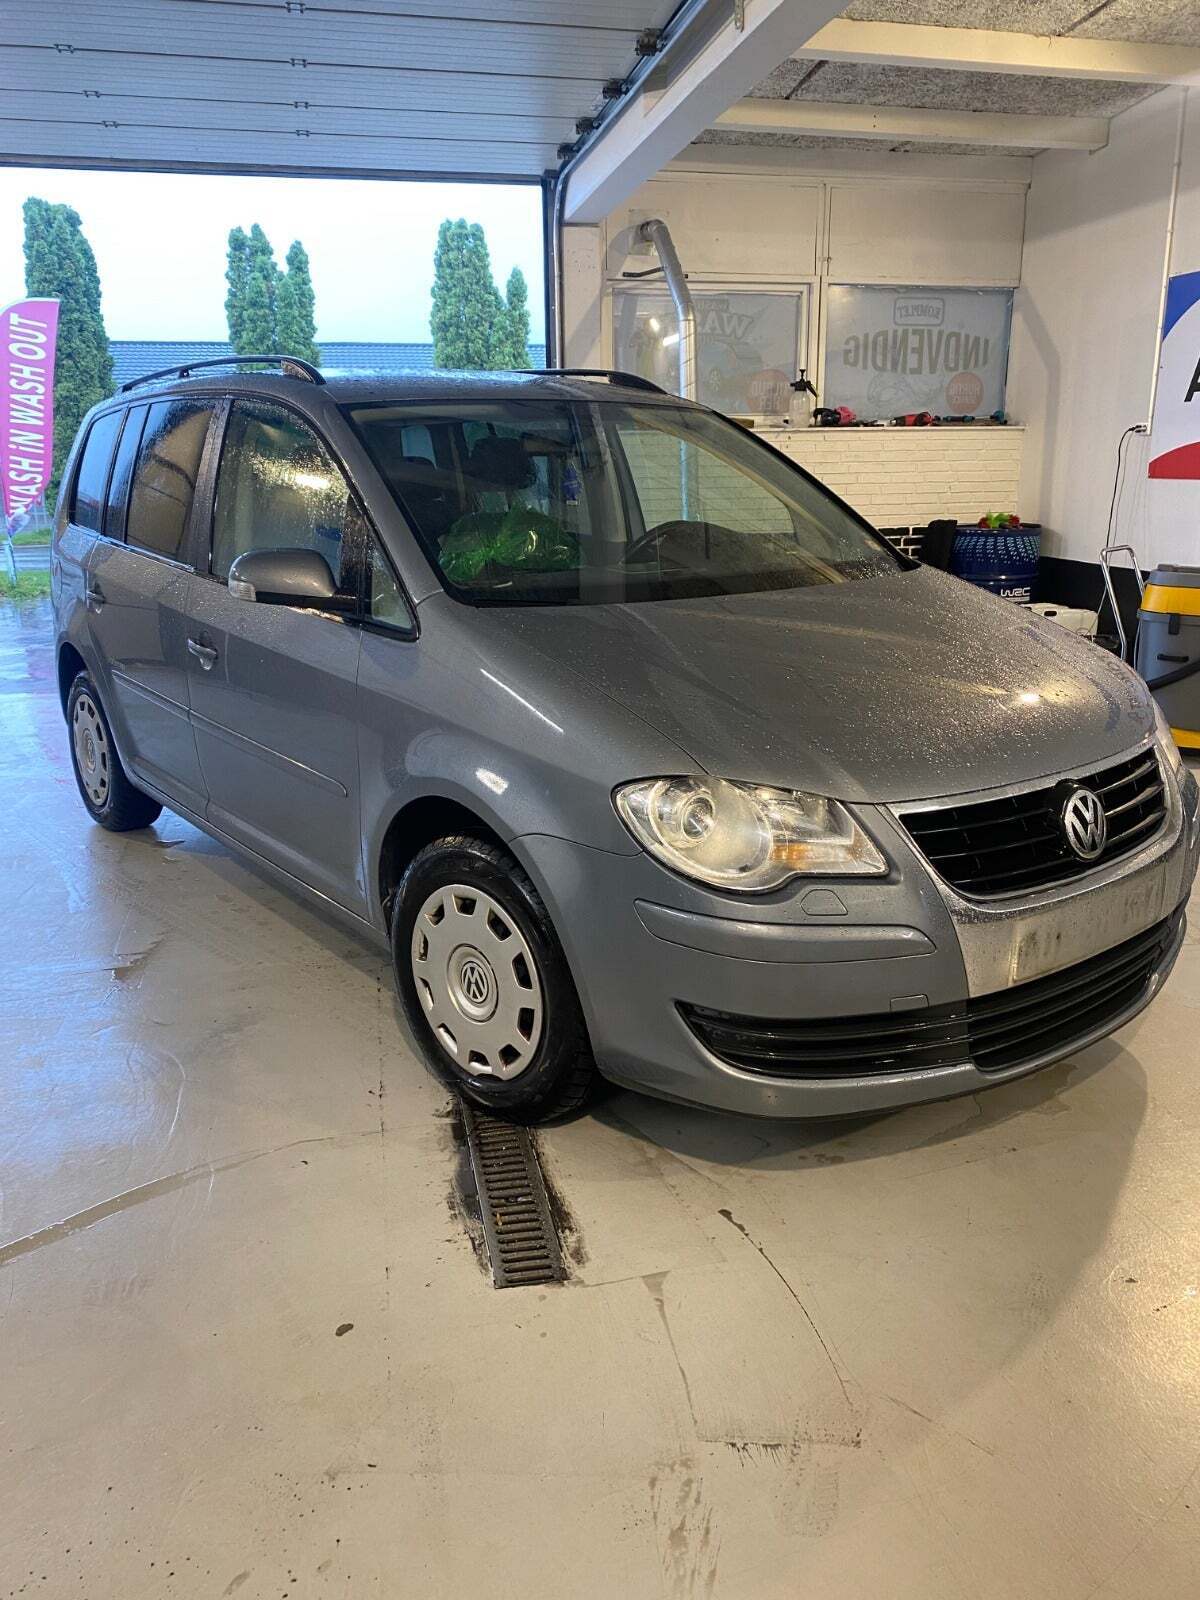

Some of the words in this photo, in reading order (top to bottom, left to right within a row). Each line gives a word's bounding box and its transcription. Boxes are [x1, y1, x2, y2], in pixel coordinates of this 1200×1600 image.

[8, 312, 47, 360] OUT
[9, 363, 45, 425] WASH
[9, 455, 43, 514] WASH
